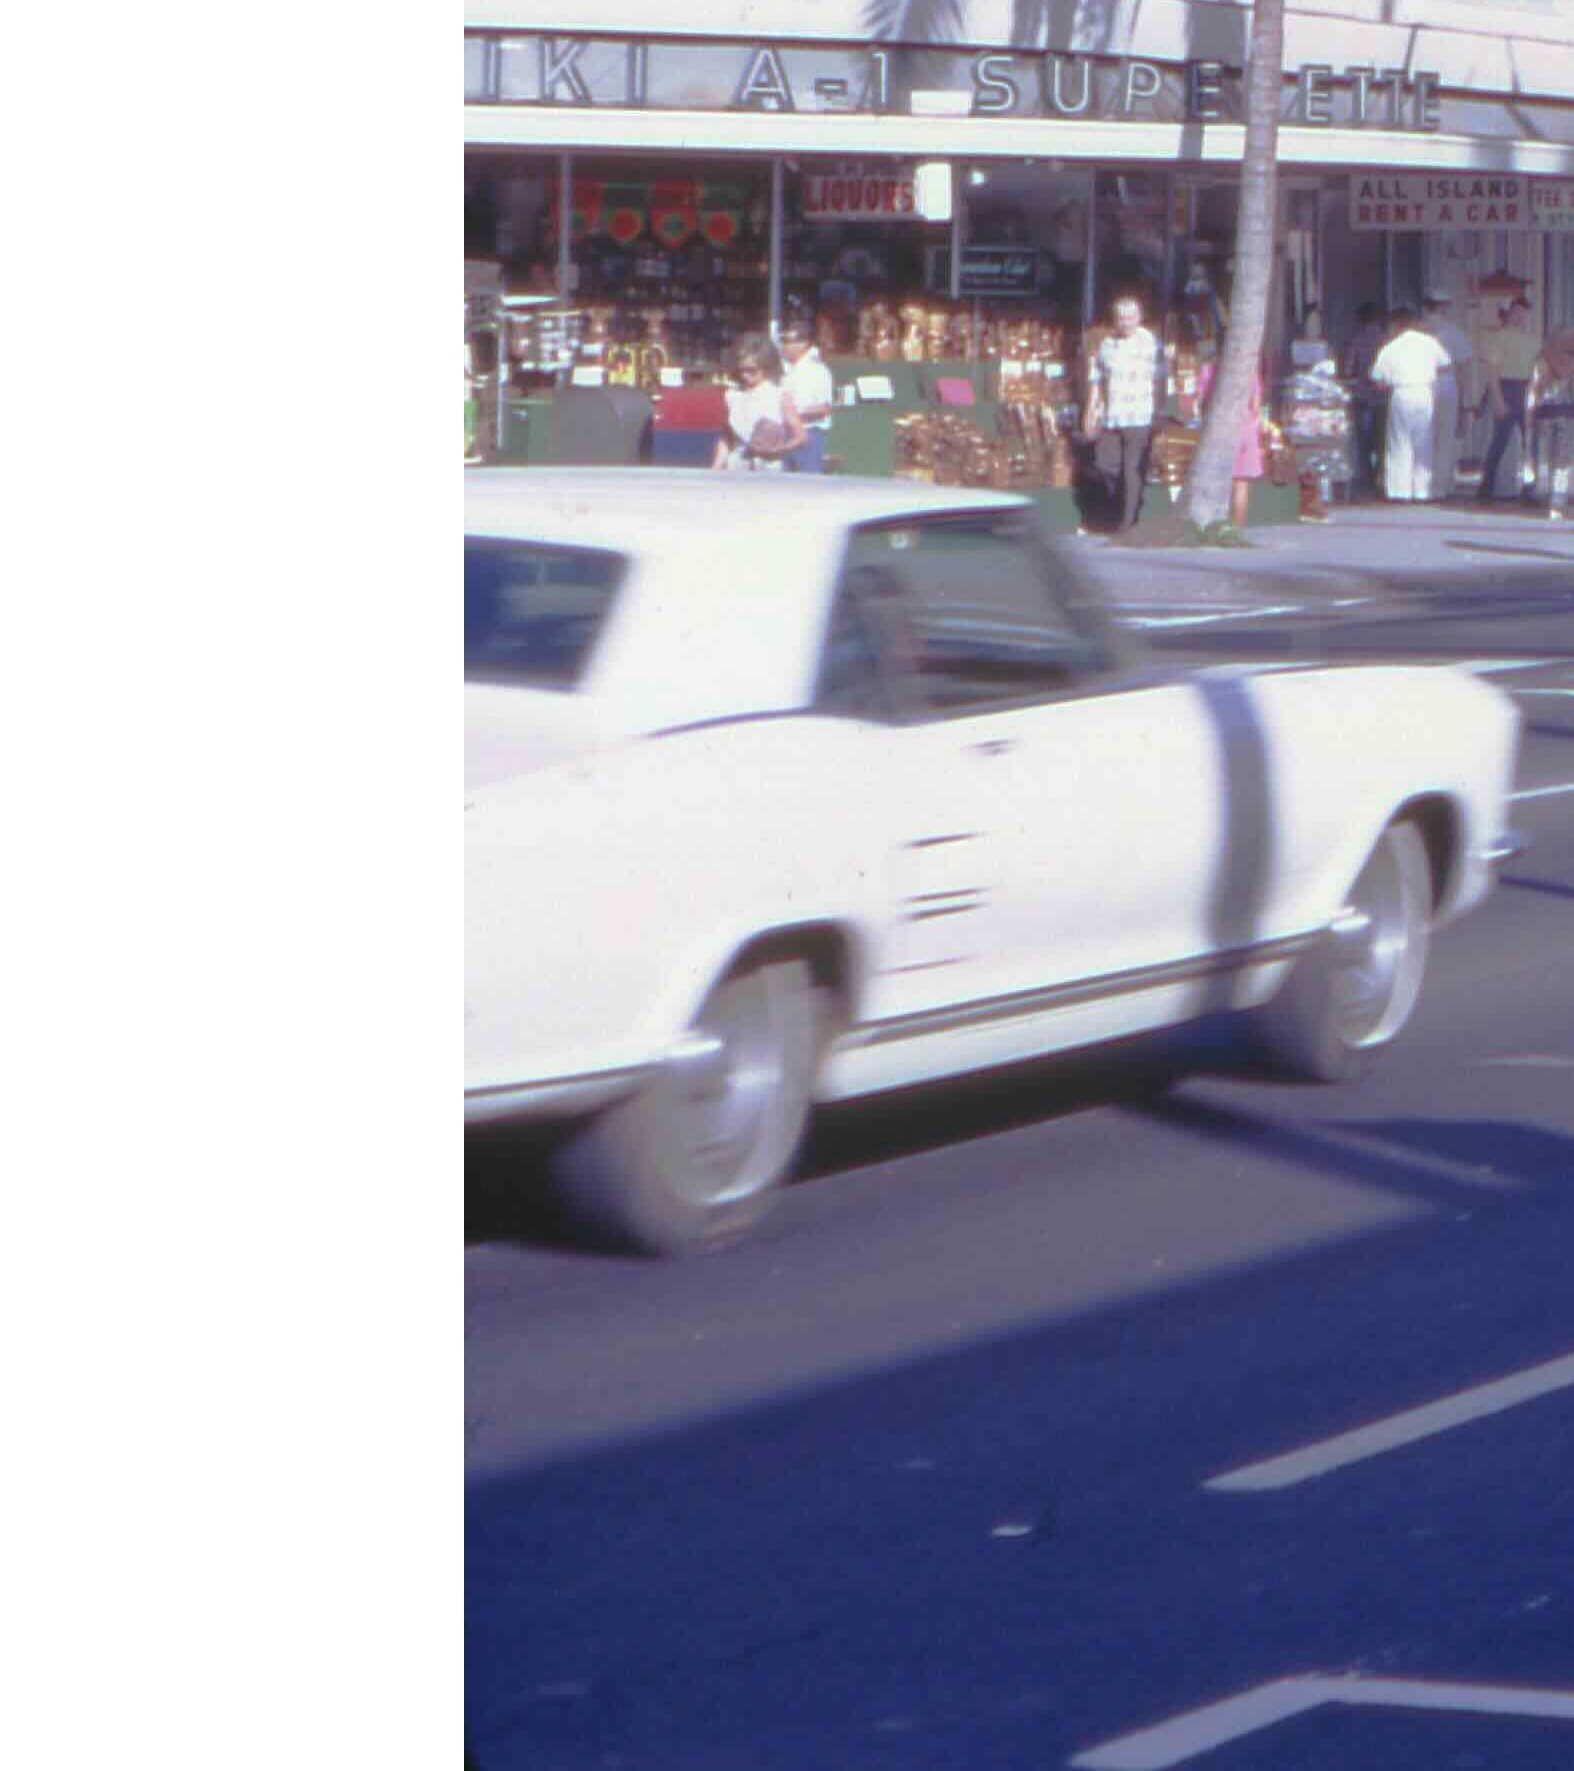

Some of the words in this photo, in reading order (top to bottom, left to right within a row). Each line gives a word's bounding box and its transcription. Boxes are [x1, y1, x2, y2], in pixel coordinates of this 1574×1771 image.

[733, 44, 891, 112] A-1
[971, 52, 1441, 129] SUPEETTE
[804, 179, 915, 212] LIQUORS
[1360, 180, 1409, 199] ALL
[1427, 180, 1520, 200] ISLAND
[1358, 204, 1425, 223] RENT
[1439, 204, 1452, 222] A
[1466, 204, 1519, 223] CAR
